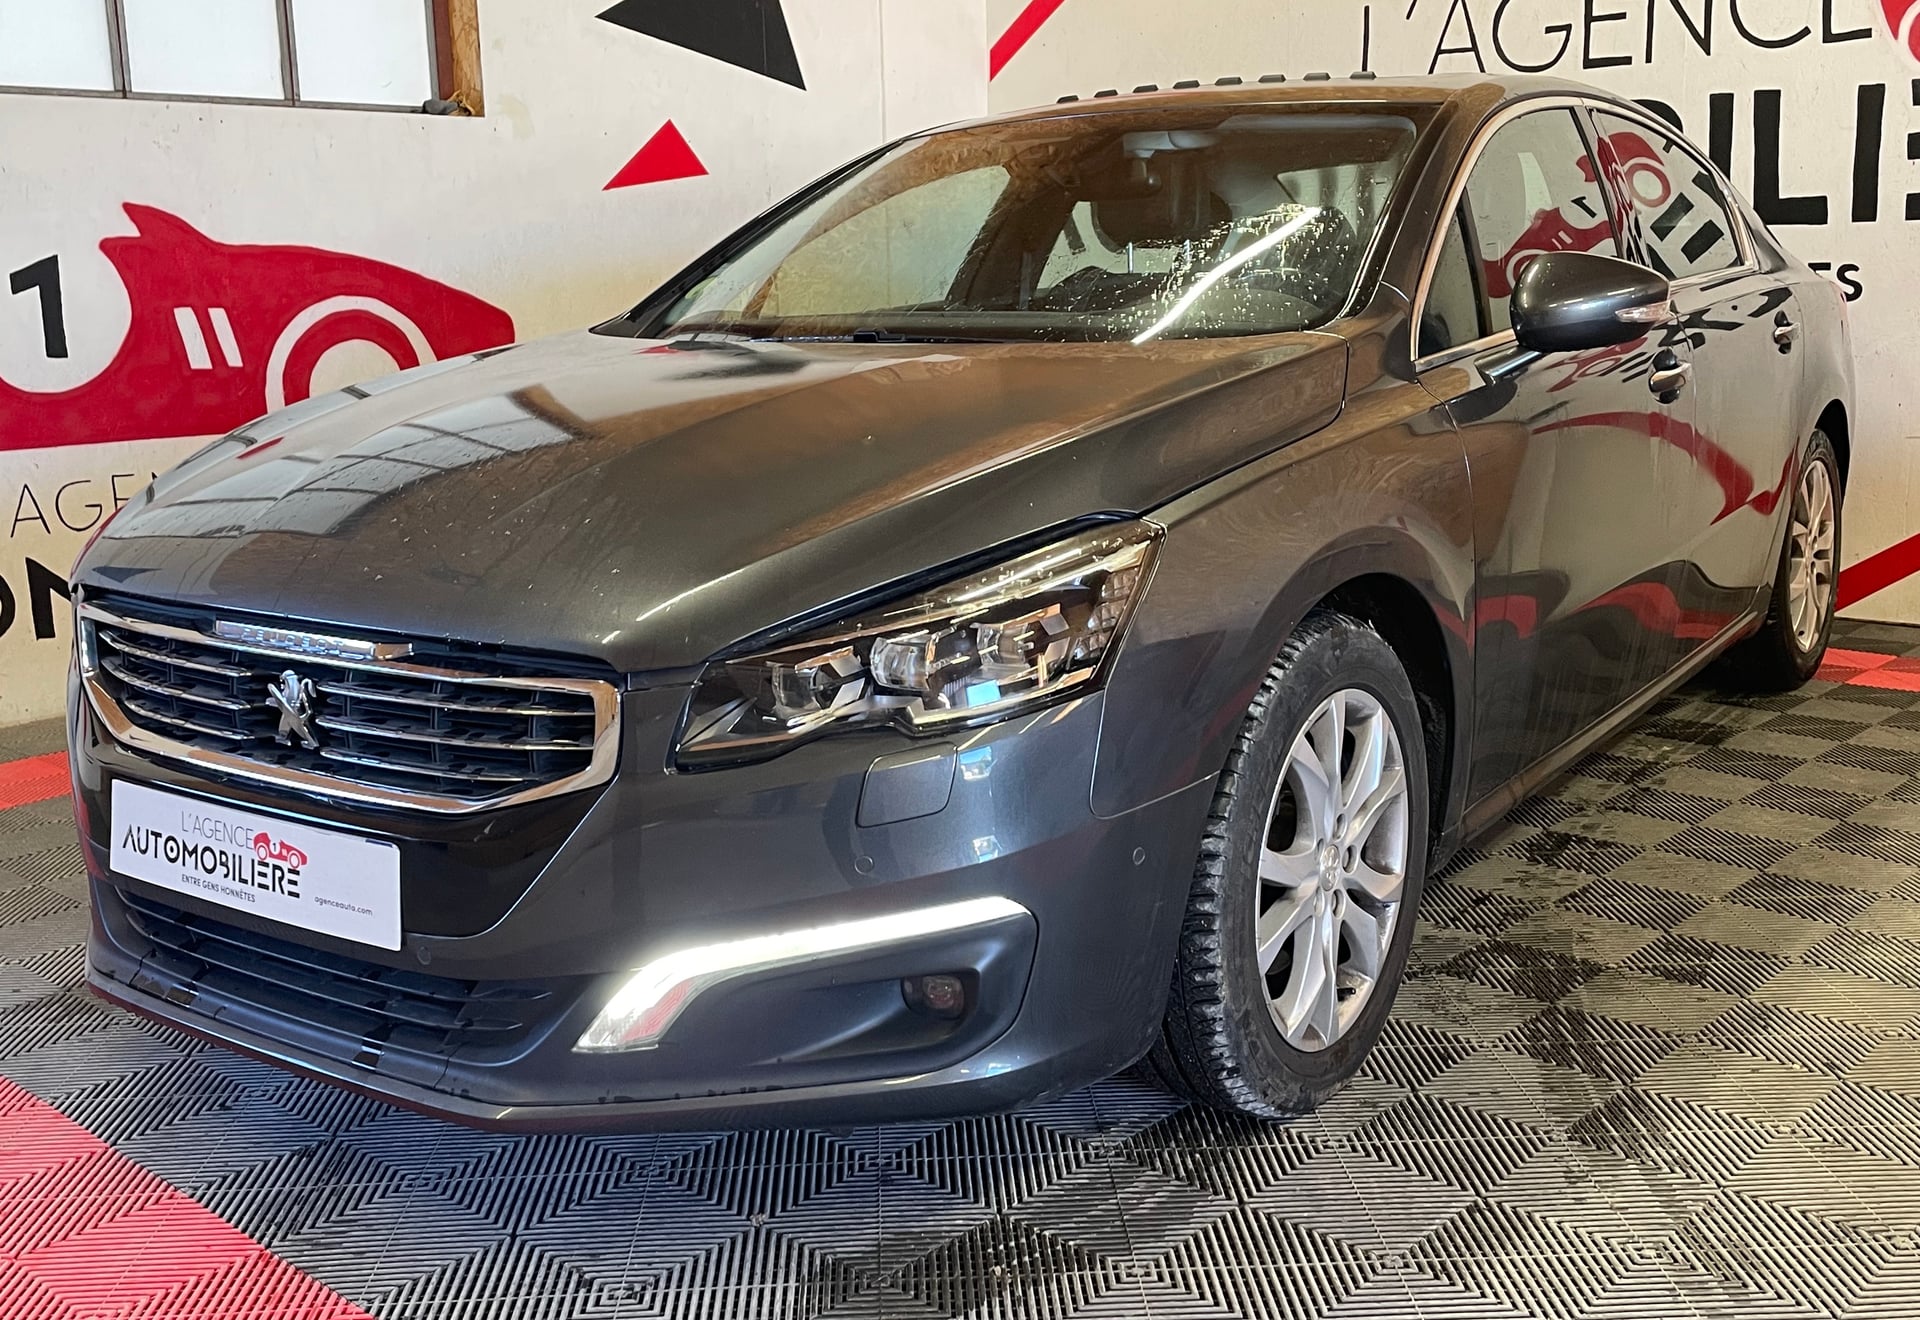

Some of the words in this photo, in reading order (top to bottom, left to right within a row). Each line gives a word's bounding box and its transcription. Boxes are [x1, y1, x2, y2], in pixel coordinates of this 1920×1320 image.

[1632, 79, 1920, 225] ILI
[10, 254, 69, 359] 1
[10, 470, 158, 538] AGE
[181, 810, 254, 849] L'AGENCE
[181, 873, 201, 887] ENTRE
[202, 880, 220, 893] GENS
[220, 885, 256, 903] HONNÊTES
[314, 896, 373, 916] agenceauto.com
